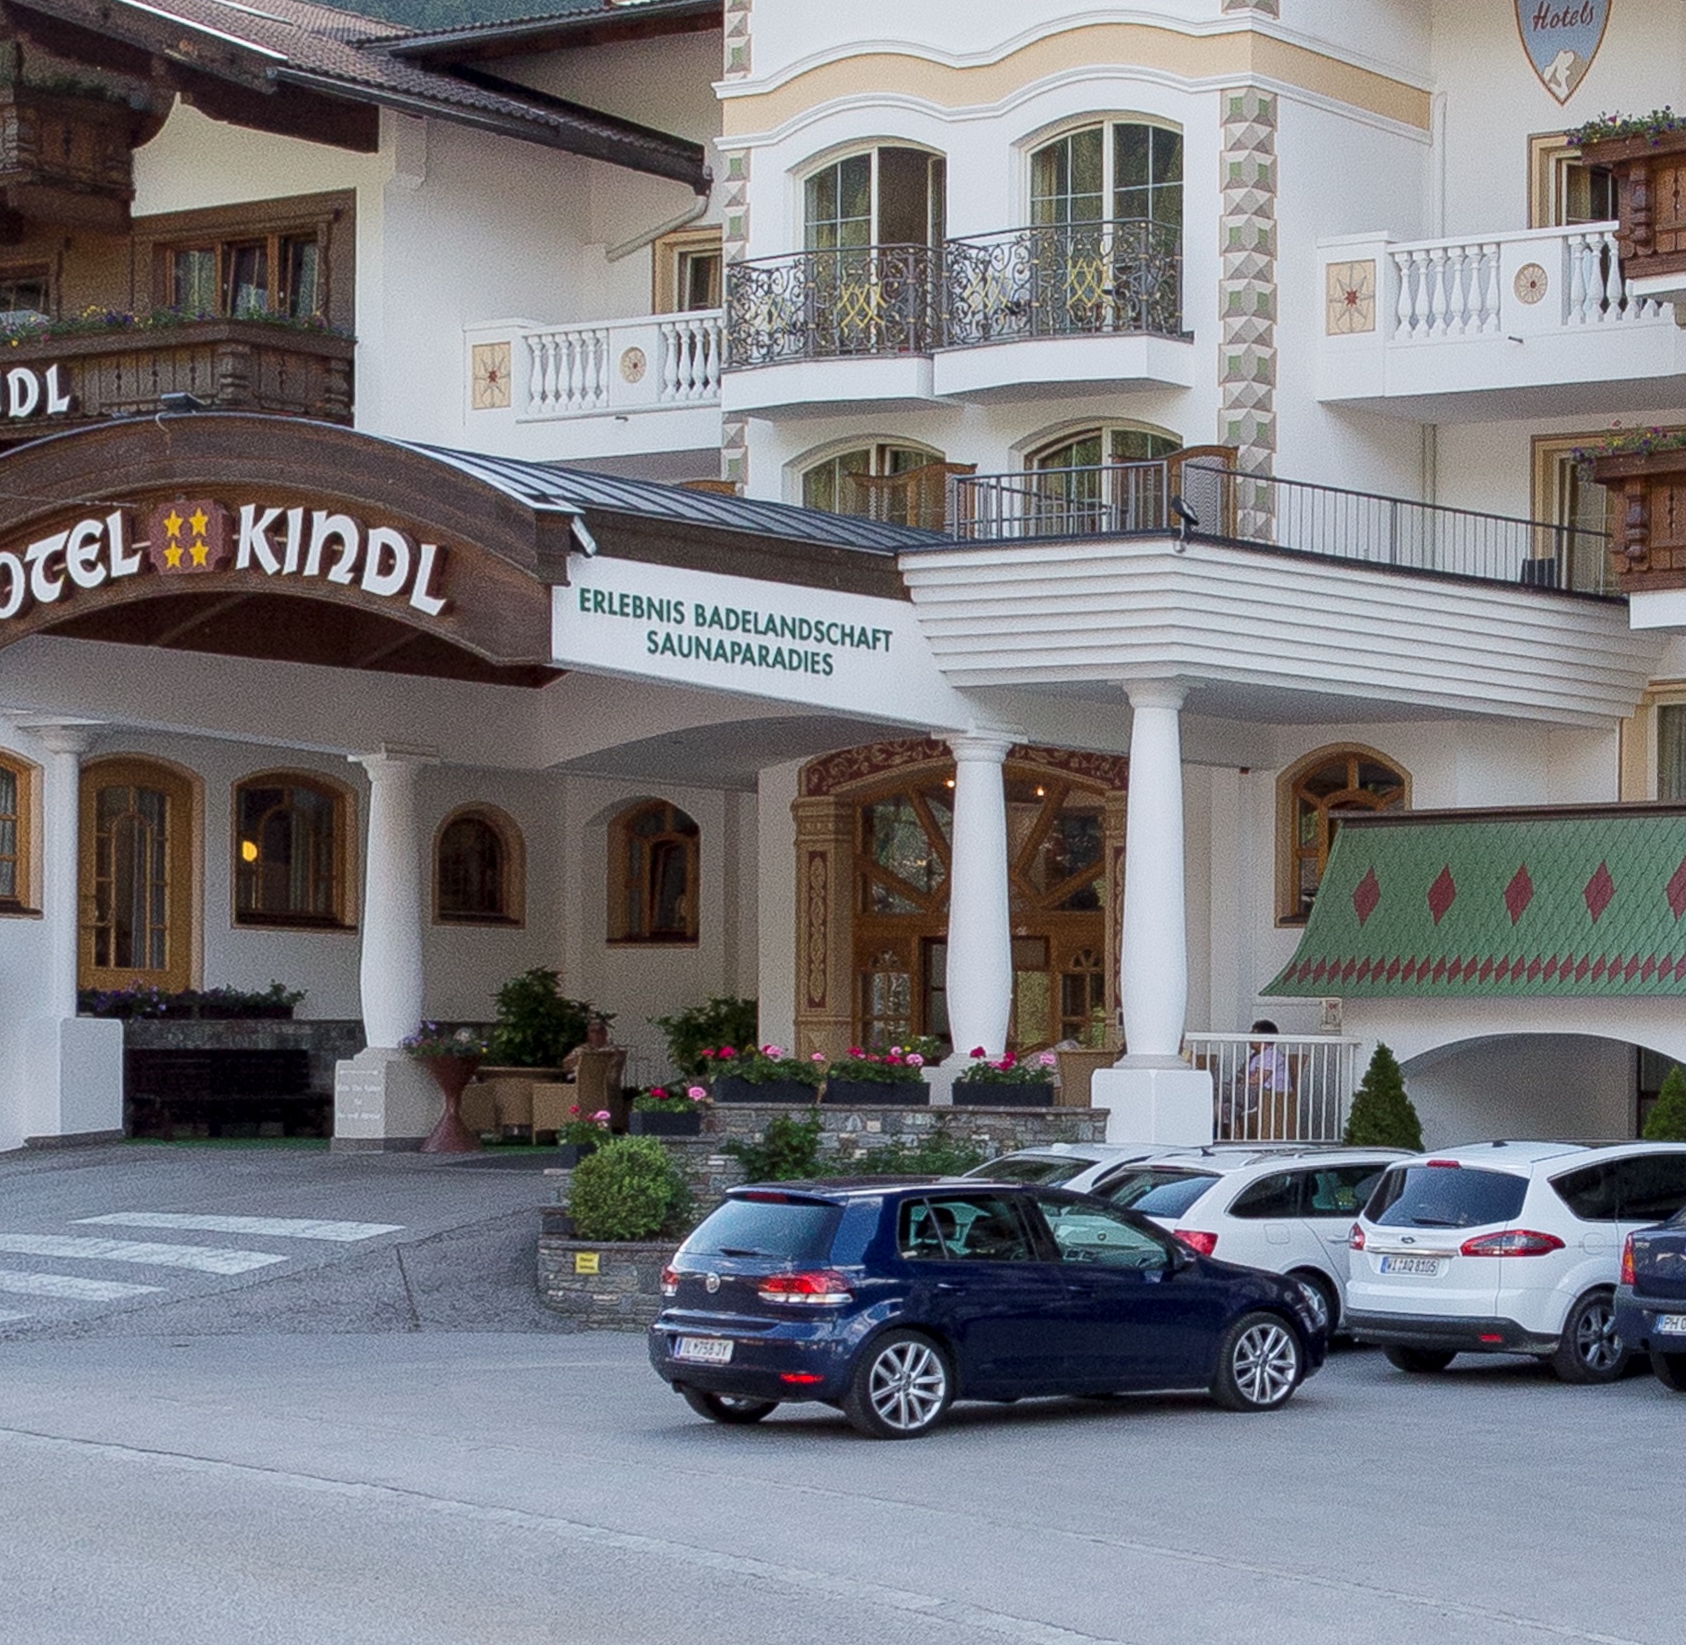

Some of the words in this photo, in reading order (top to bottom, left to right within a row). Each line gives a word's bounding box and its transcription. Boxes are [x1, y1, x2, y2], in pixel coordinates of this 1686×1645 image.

[1532, 0, 1595, 32] Hotels
[234, 503, 448, 617] KINDL
[578, 586, 686, 625] ERLEBNIS
[693, 602, 894, 654] BADELANDSCHAFT
[646, 630, 835, 676] SAUNAPARADIES
